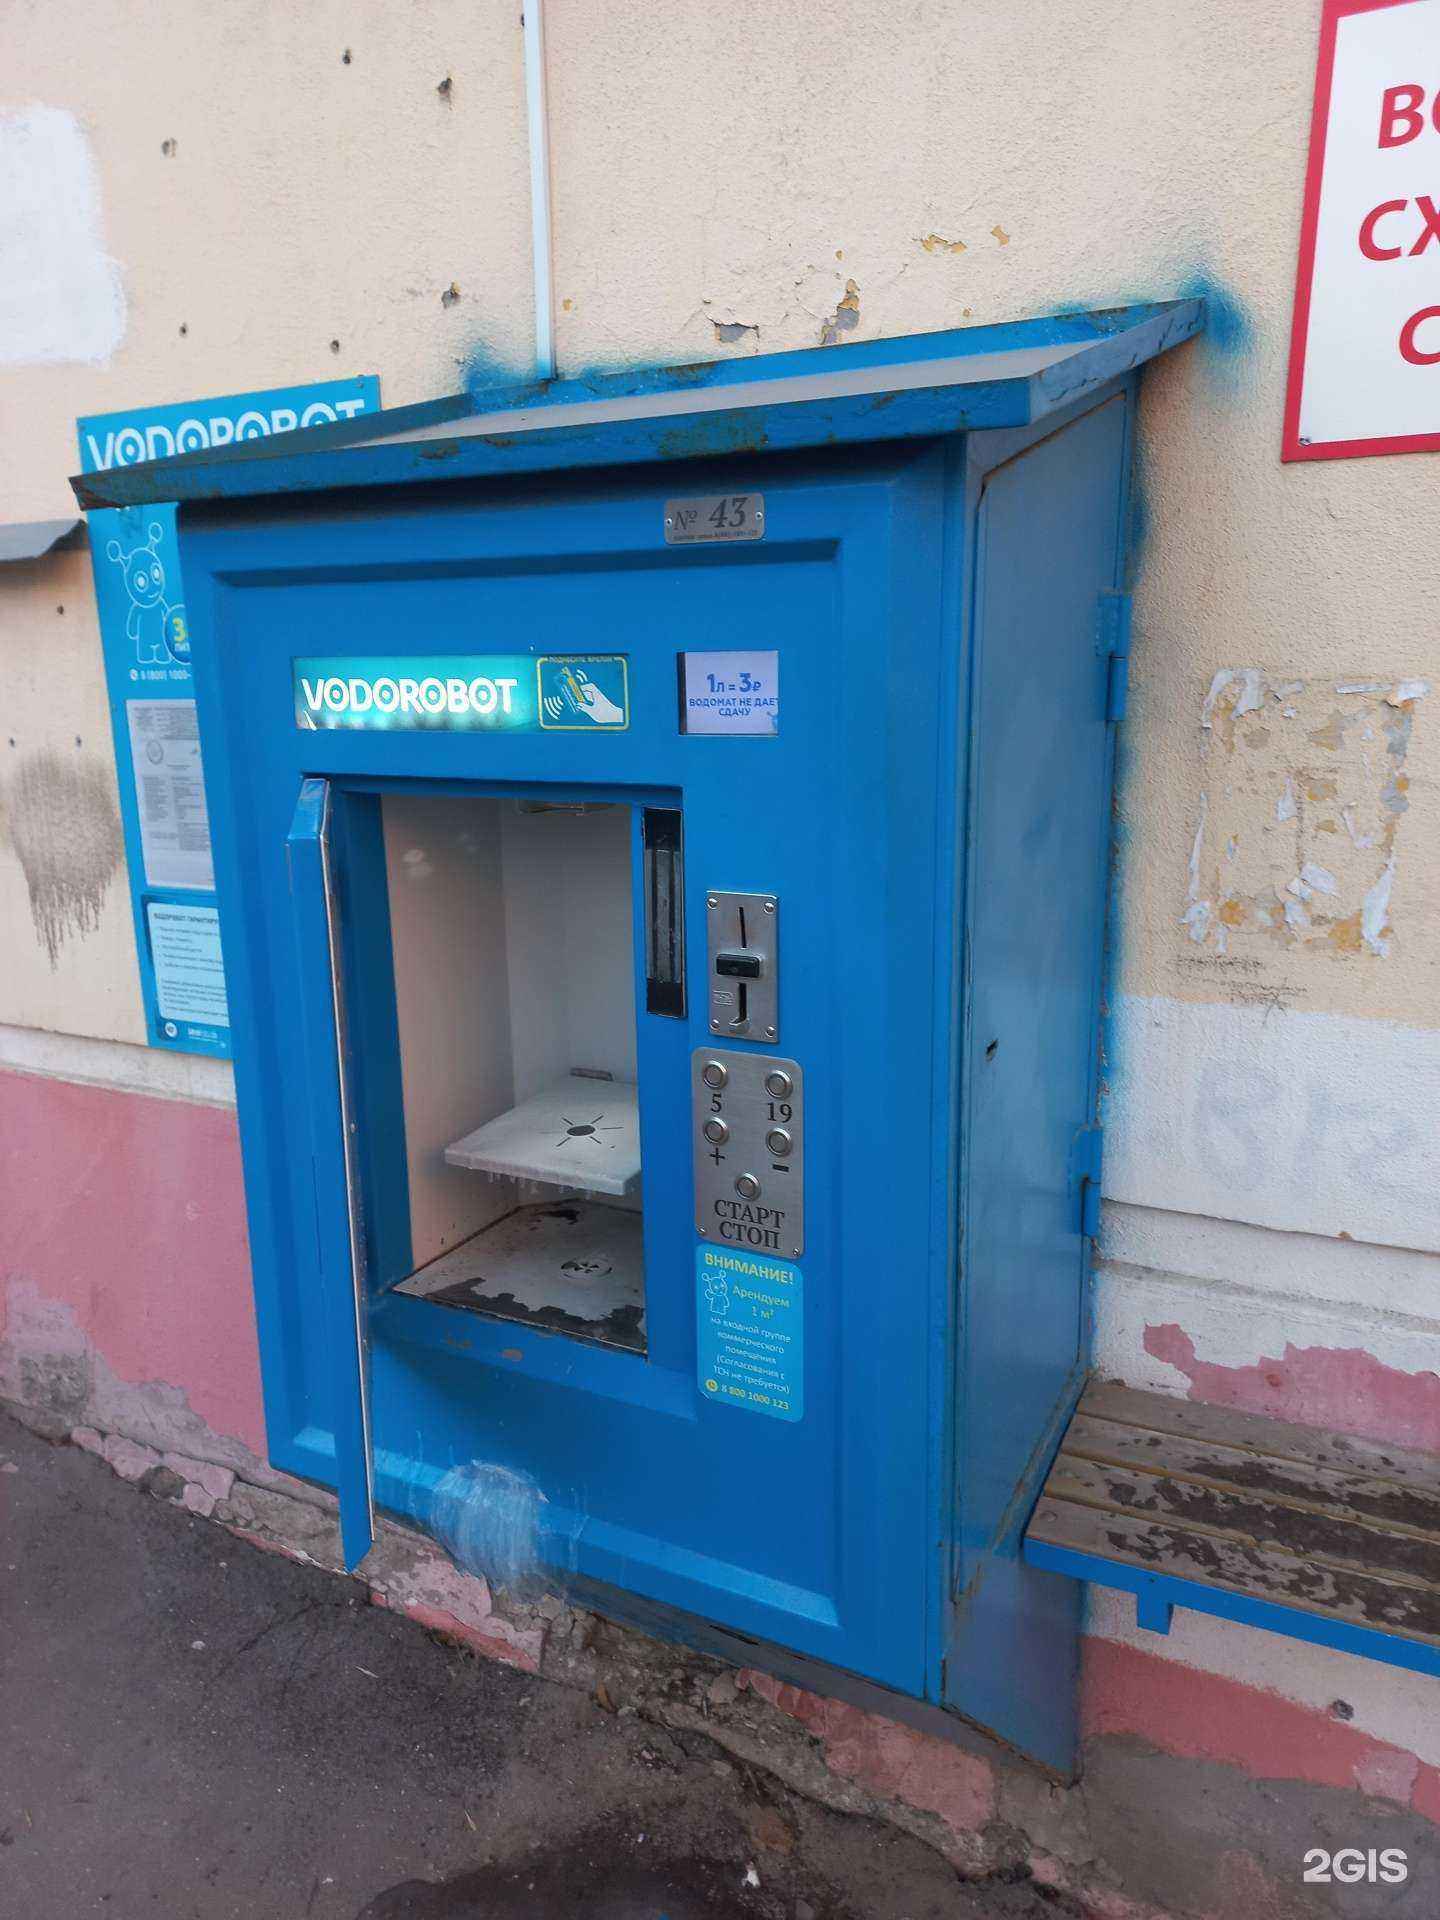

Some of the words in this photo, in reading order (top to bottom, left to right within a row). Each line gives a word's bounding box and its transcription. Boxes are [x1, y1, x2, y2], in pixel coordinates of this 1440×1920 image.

[1378, 83, 1440, 149] В
[674, 510, 698, 530] №
[708, 497, 749, 528] 43
[301, 677, 518, 714] VODOROBOT
[689, 698, 737, 708] ВОДОМАТ
[739, 697, 752, 706] НЕ
[718, 707, 752, 717] СДАЧУ
[710, 1093, 722, 1113] 5
[767, 1102, 793, 1123] 19
[714, 1199, 785, 1229] СТАРТ
[719, 1221, 780, 1250] СТОП
[704, 1252, 793, 1285] ВНИМАНИЕ!
[732, 1286, 790, 1308] Арендуем
[752, 1305, 758, 1317] 1
[717, 1331, 784, 1354] коммерческого
[723, 1320, 760, 1335] входной
[761, 1329, 791, 1343] группе
[725, 1345, 777, 1364] помещения
[743, 1375, 790, 1395] требуется)
[773, 1399, 789, 1411] 123
